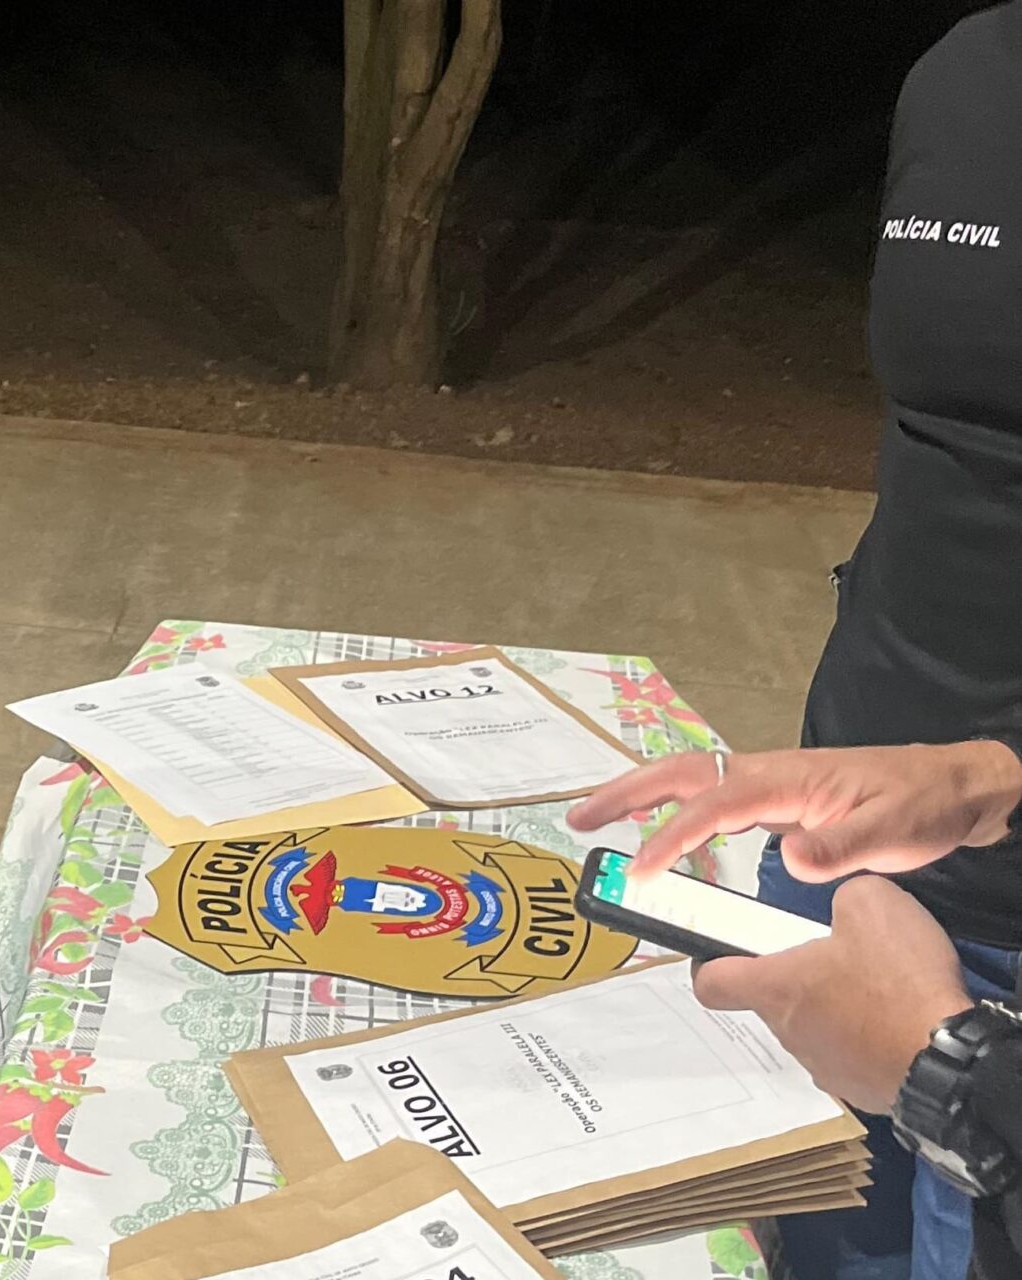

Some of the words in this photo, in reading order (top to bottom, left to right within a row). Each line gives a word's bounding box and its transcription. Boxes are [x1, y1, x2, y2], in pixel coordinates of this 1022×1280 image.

[882, 214, 943, 241] POLÍCIA
[946, 222, 1001, 247] CIVIL
[375, 688, 452, 704] ALVO
[461, 685, 499, 696] 12
[190, 841, 270, 934] POLÍCIA
[524, 878, 575, 956] CIVIL
[500, 1023, 517, 1034] III
[511, 1034, 548, 1072] PARALELA
[377, 1060, 420, 1090] 06
[561, 1092, 596, 1133] Operação
[586, 1099, 602, 1112] OS
[404, 1096, 475, 1157] ALVO
